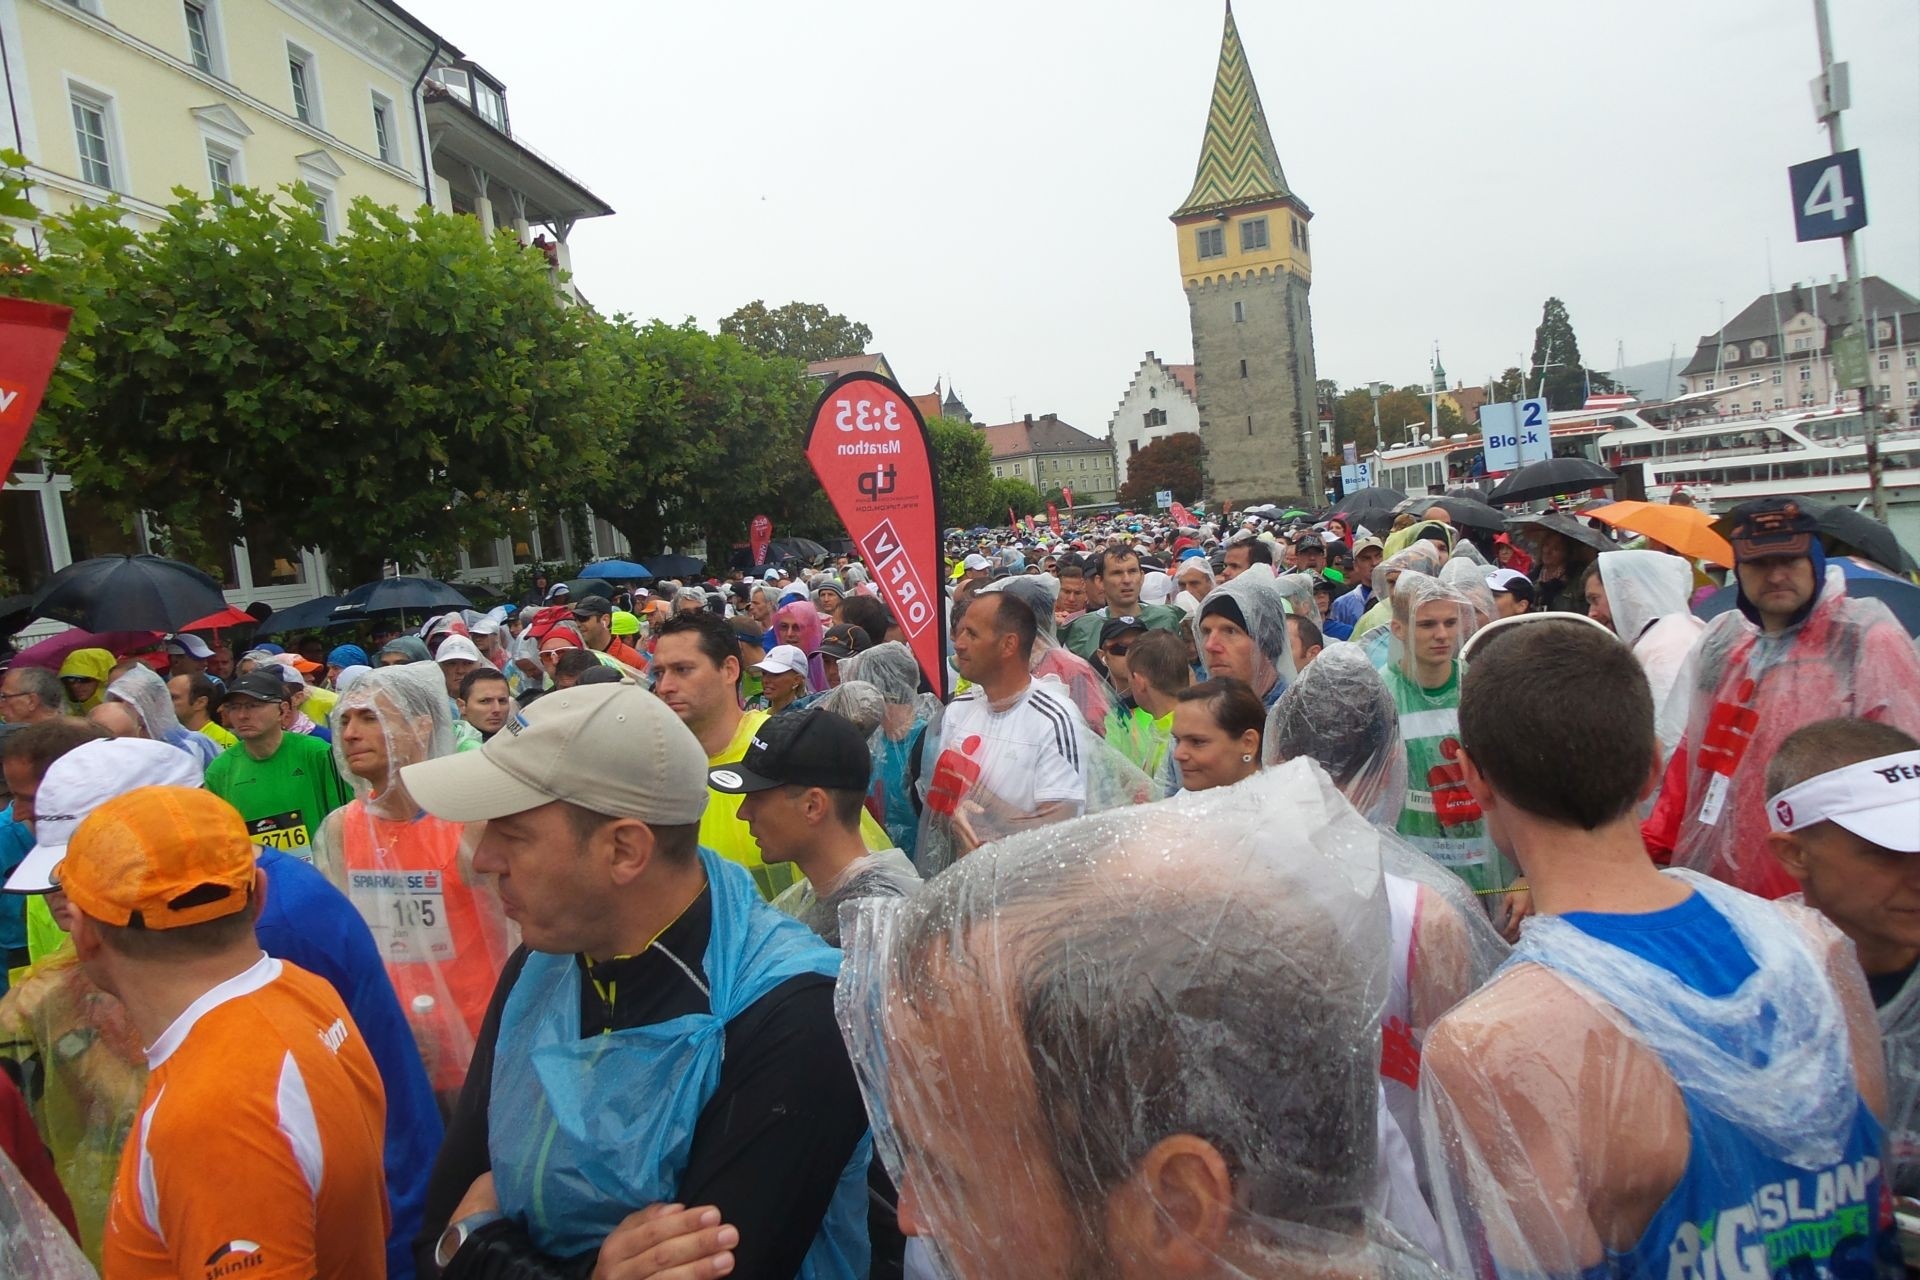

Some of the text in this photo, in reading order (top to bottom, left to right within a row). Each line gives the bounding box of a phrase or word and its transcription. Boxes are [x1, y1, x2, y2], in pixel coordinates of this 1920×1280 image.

[1804, 164, 1854, 221] 4
[1522, 402, 1542, 427] 2
[1489, 431, 1539, 449] Block
[1359, 464, 1368, 475] 3
[206, 1254, 264, 1280] skinfit
